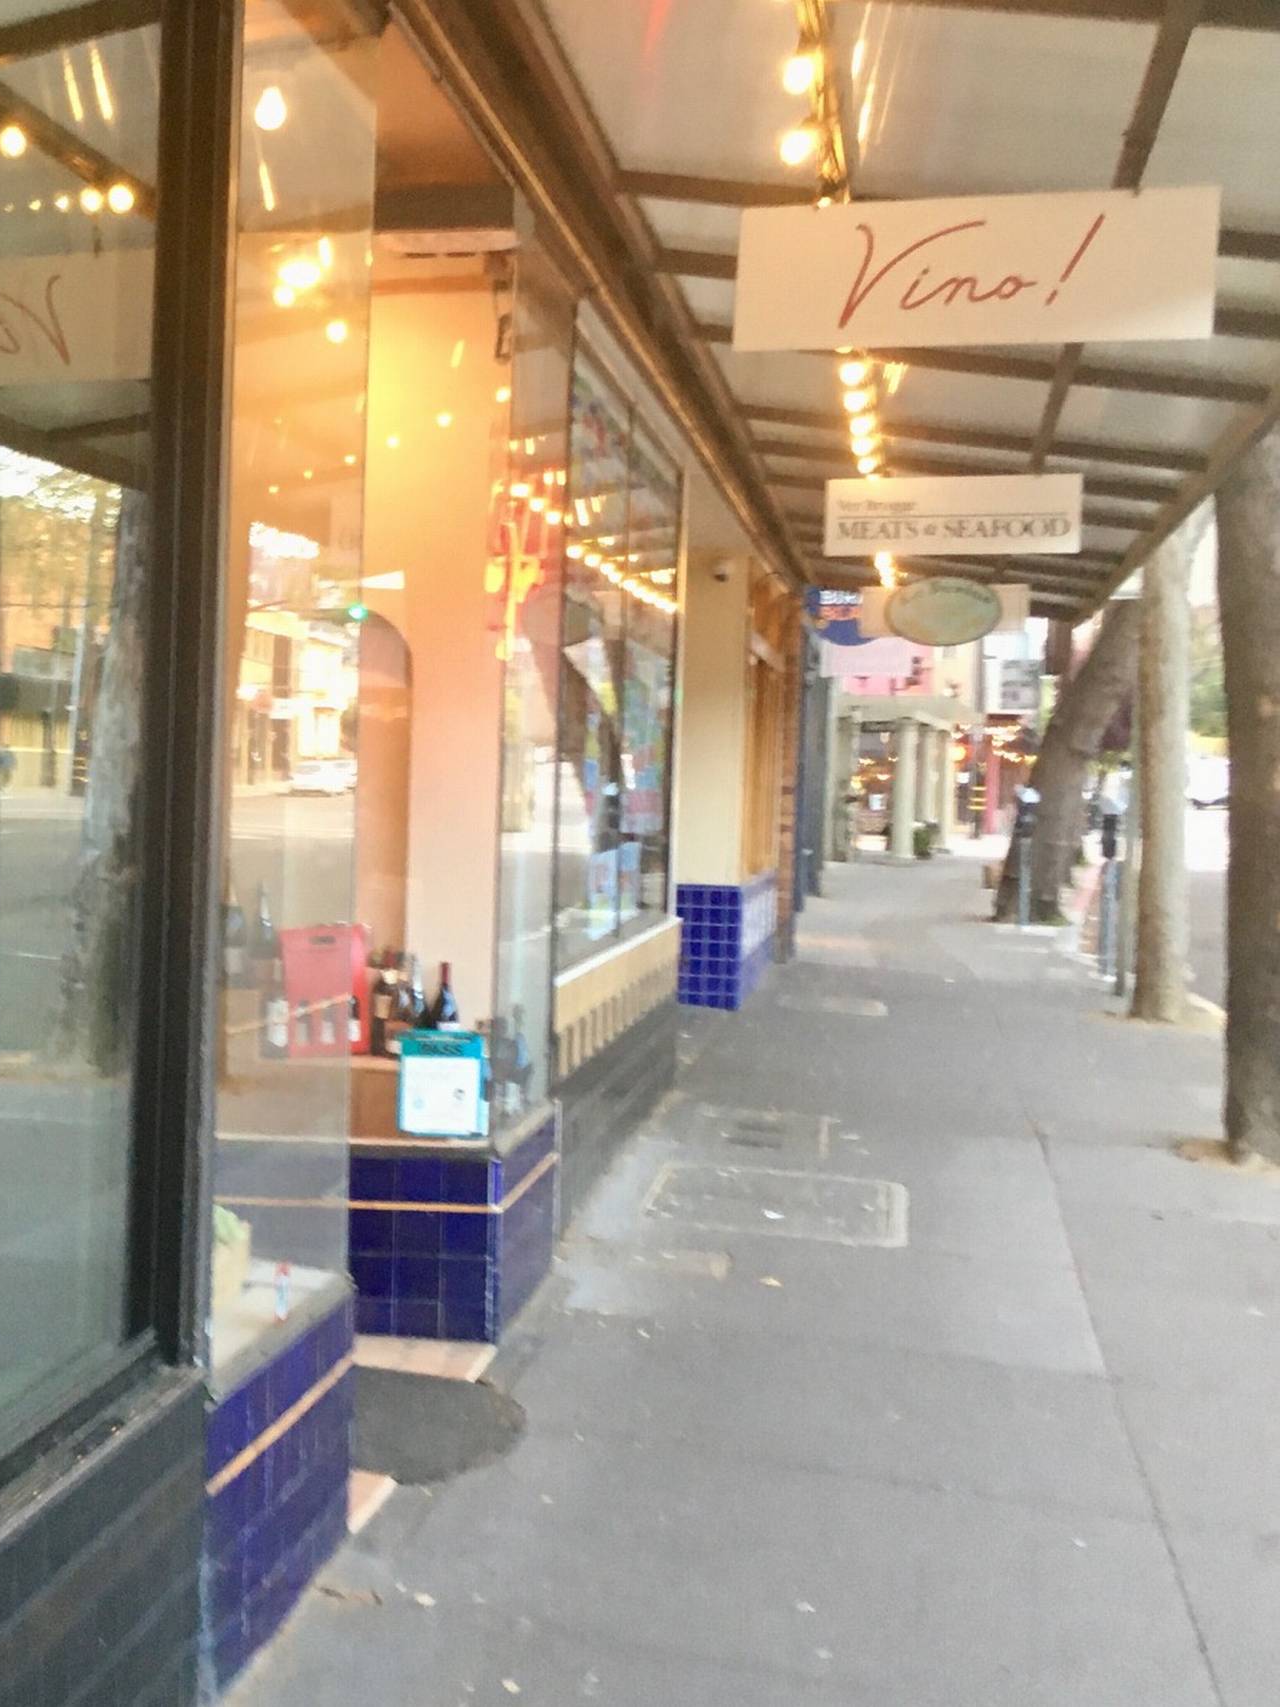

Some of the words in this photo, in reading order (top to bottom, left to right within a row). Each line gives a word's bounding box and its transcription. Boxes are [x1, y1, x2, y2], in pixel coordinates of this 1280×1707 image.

[838, 212, 1105, 328] Vino!
[838, 521, 919, 540] MEATS
[942, 517, 1072, 538] SEAFOOD
